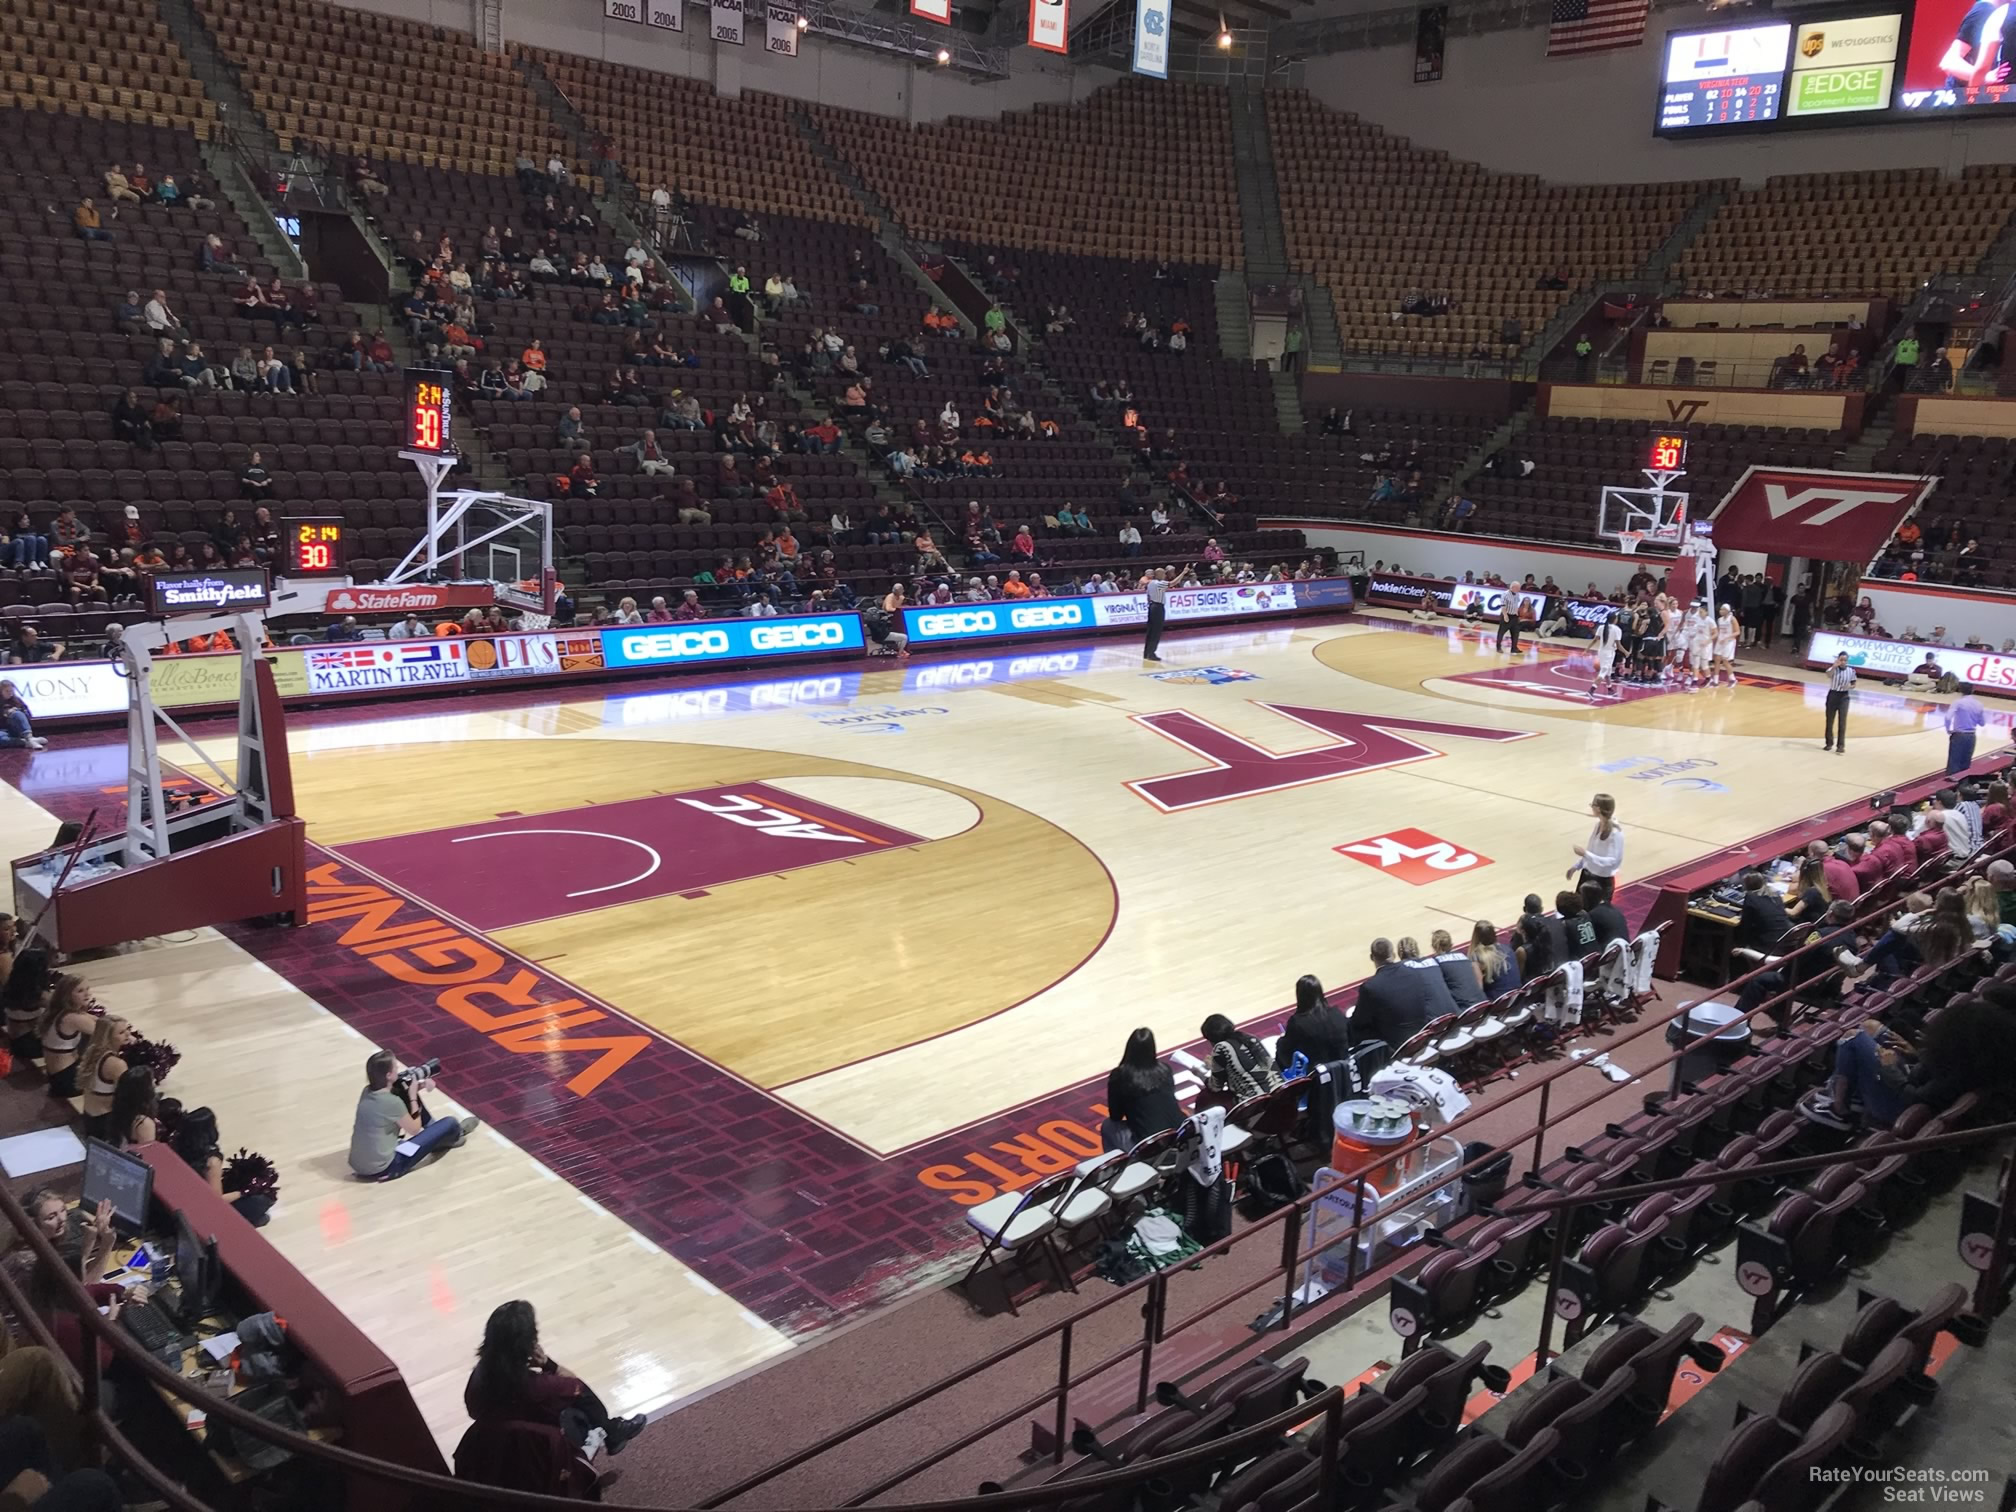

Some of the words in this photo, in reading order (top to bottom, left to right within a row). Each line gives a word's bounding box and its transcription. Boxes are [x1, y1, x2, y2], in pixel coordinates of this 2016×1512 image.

[612, 3, 635, 18] 2003
[713, 0, 742, 12] NCAA
[654, 11, 676, 28] 2004
[768, 9, 795, 24] NCAA
[1040, 19, 1058, 32] MIAMI
[717, 26, 738, 41] 2005
[1832, 40, 1843, 48] WE
[1853, 35, 1894, 46] LOGISTICS
[771, 37, 791, 52] 2006
[1804, 38, 1823, 55] ups
[1804, 76, 1816, 94] the
[1814, 71, 1879, 94] EDGE
[1902, 91, 1933, 108] VT
[418, 384, 441, 405] 2:14
[1667, 400, 1710, 422] VT
[416, 408, 438, 447] 30
[1656, 449, 1677, 468] 30
[1764, 484, 1909, 526] VT
[300, 526, 338, 543] 2:14
[301, 545, 328, 568] 30
[156, 581, 183, 590] Flavor
[1104, 604, 1136, 614] VIRGINIA
[1169, 592, 1228, 608] FASTSIGNS
[918, 610, 997, 636] GEICO
[1011, 604, 1082, 628] GEICO
[622, 630, 730, 660] GEICO
[750, 622, 845, 650] GEICO
[499, 635, 554, 668] PK's
[1836, 636, 1916, 656] HOMEWOOD
[1872, 652, 1912, 666] SUITES
[316, 668, 394, 689] MARTIN
[393, 662, 465, 683] TRAVEL
[1121, 699, 1548, 815] VT
[675, 794, 866, 842] ACC
[1340, 837, 1478, 870] 2K
[1744, 1268, 1770, 1286] VT
[1396, 1316, 1414, 1330] VT
